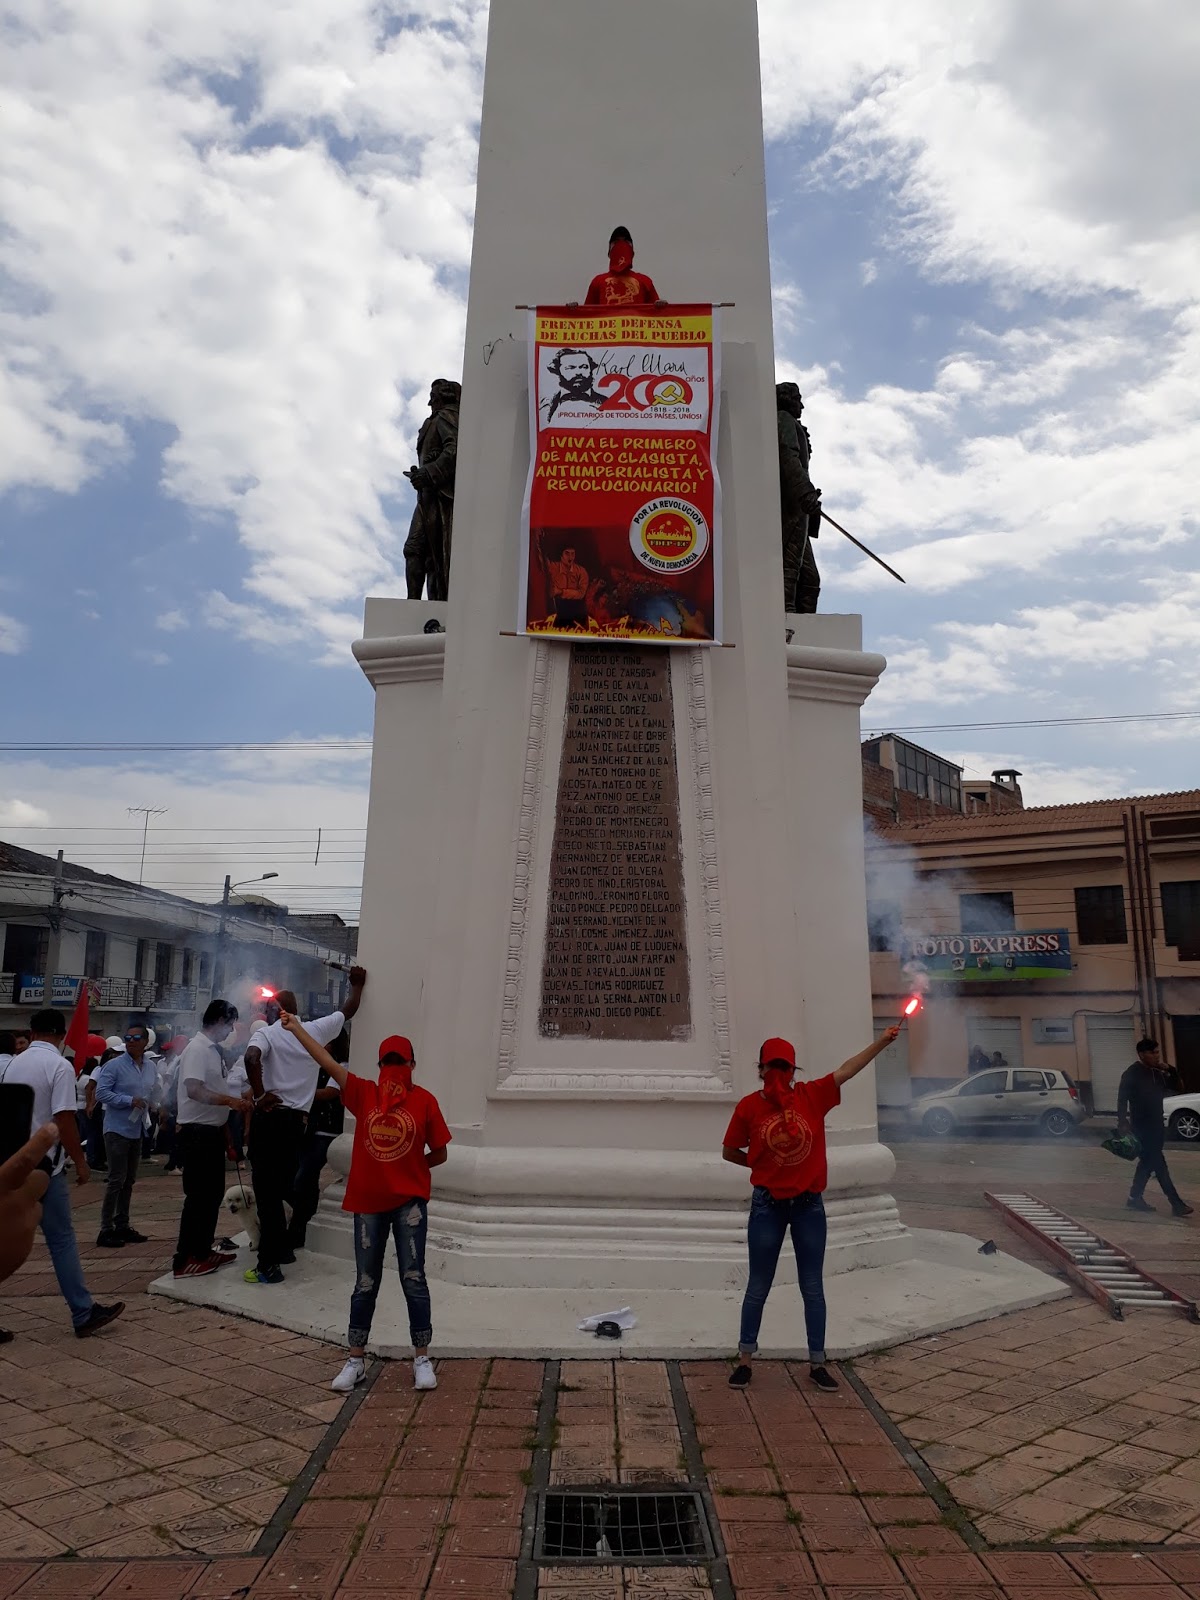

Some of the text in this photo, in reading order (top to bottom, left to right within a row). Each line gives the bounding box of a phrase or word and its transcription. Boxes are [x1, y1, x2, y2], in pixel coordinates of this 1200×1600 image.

[541, 319, 682, 329] FRENTE DE DEFENSA
[540, 331, 706, 340] DE LUCHAS DEL PUEBLO
[596, 350, 635, 377] Karl
[598, 374, 693, 412] 200
[550, 436, 696, 450] ¡VIVA EL PRIMERO
[541, 451, 702, 466] DE MAYO CLASISTA,
[536, 465, 709, 481] ANTIIMPERIALISTA Y
[547, 479, 697, 493] REVOLUCIONARIO!
[634, 500, 703, 525] POR LA REVOLUCION
[640, 551, 698, 569] DE NUEVA DEMOCRACIA
[582, 668, 602, 678] JUAN
[606, 668, 616, 678] DE
[584, 680, 608, 690] TOMAS
[612, 680, 622, 690] DE
[570, 692, 590, 702] JUAN
[594, 692, 605, 702] DE
[607, 692, 628, 702] LEON
[577, 718, 612, 728] ANTONIO
[615, 718, 625, 728] DE
[628, 718, 640, 728] LA
[566, 731, 588, 740] JUAN
[634, 731, 644, 740] DE
[646, 731, 668, 740] ORBE
[576, 743, 660, 753] JUAN DE GALLEGOS
[567, 756, 588, 766] JUAN
[592, 756, 631, 766] SANCHEZ
[634, 756, 644, 766] DE
[578, 768, 661, 778] MATEO MORENO DE
[636, 780, 648, 790] DE
[626, 792, 638, 802] DE
[564, 817, 668, 827] PEDRO DE MONTENEGRO
[558, 841, 582, 851] CISCO
[556, 854, 608, 863] HERNANDEZ
[610, 854, 622, 863] DE
[580, 866, 609, 876] GOMEZ
[612, 866, 624, 876] DE
[554, 878, 580, 888] PEDRO
[583, 878, 594, 888] DE
[610, 904, 638, 913] PEDRO
[550, 916, 570, 926] JUAN
[646, 916, 656, 926] DE
[654, 928, 674, 938] JUAN
[548, 942, 559, 952] DE
[604, 942, 627, 952] JUAN
[630, 942, 642, 952] DE
[913, 934, 1060, 956] FOTO EXPRESS
[572, 954, 583, 964] DE
[616, 954, 638, 964] JUAN
[571, 968, 582, 977] DE
[630, 968, 650, 977] JUAN
[654, 968, 666, 977] DE
[32, 978, 70, 986] PAPERIA
[615, 980, 664, 990] RODRIGUEZ
[574, 994, 585, 1004] DE
[588, 994, 600, 1004] LA
[606, 1007, 632, 1018] DIEGO
